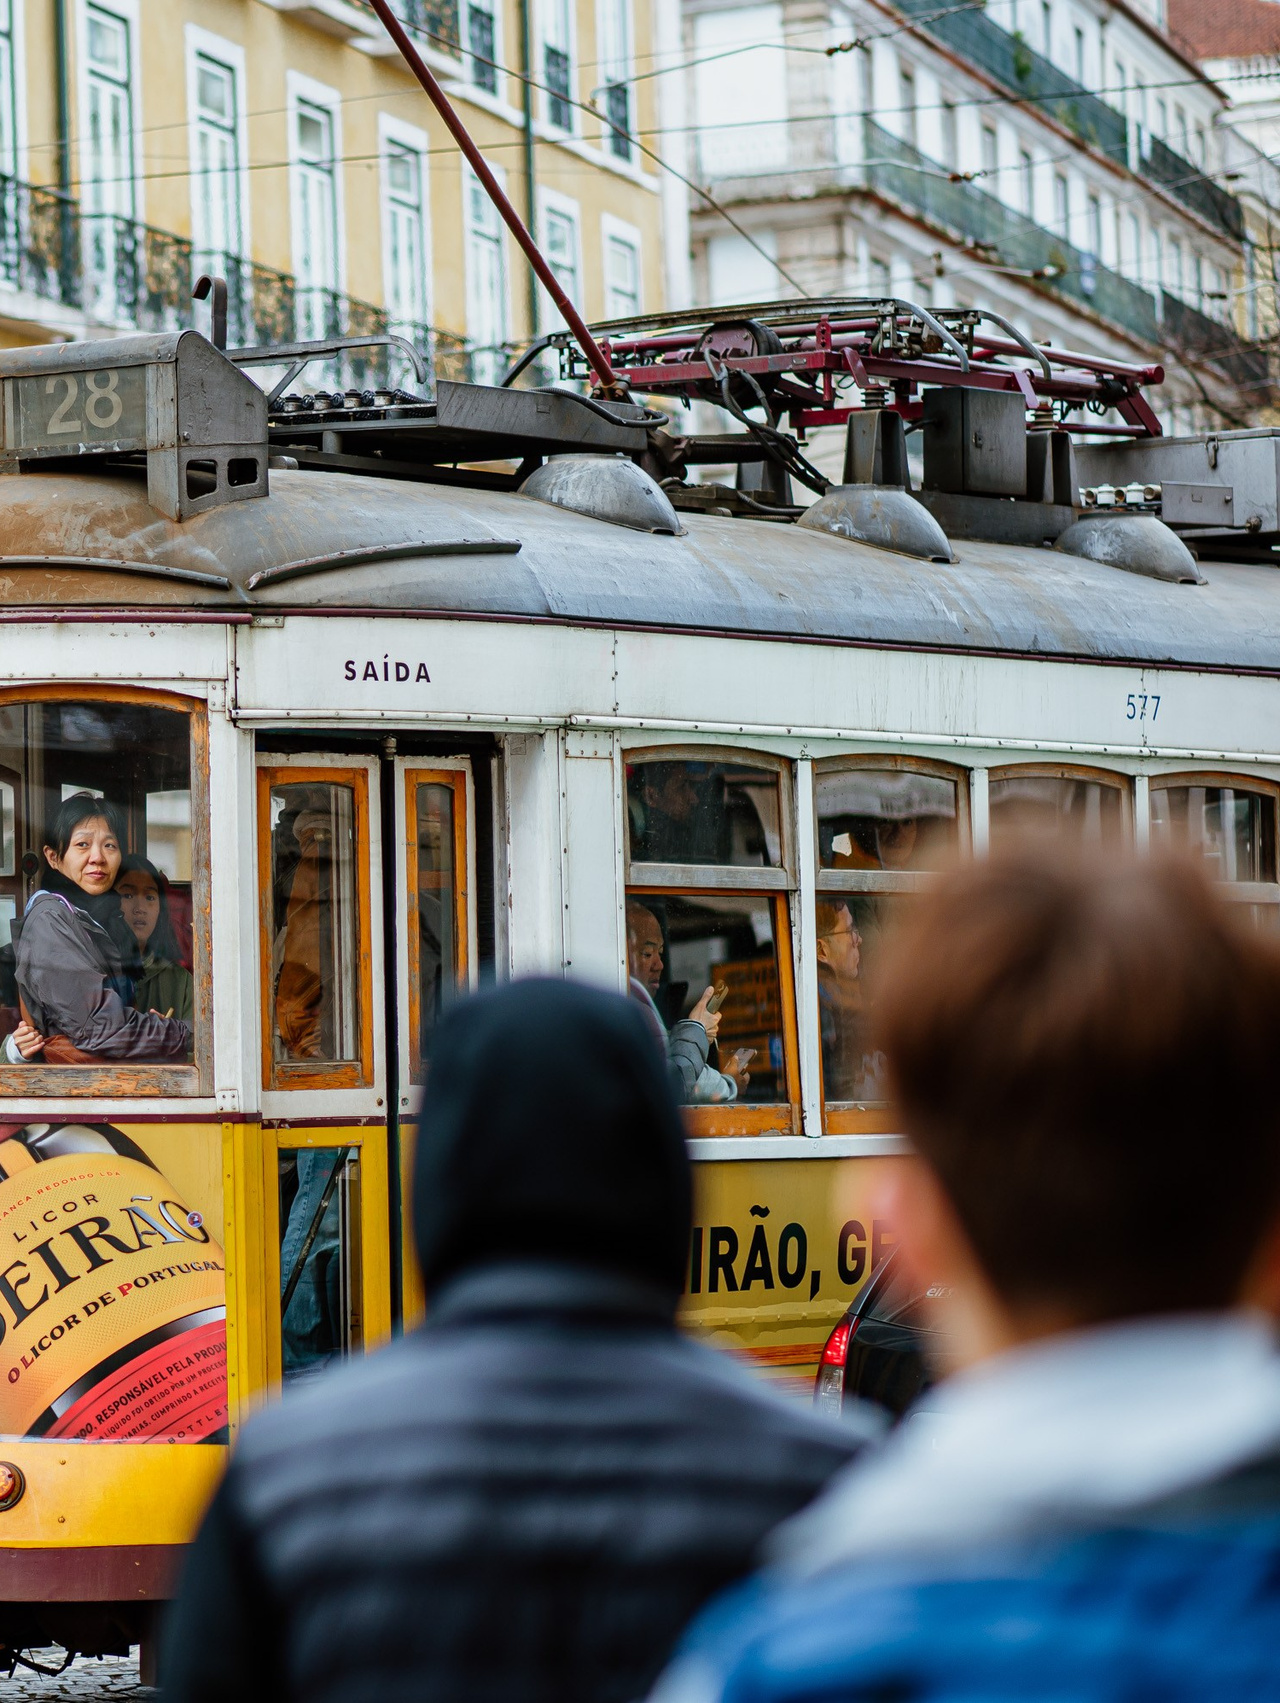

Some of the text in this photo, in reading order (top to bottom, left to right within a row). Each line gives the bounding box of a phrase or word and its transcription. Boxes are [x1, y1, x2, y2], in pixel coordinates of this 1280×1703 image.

[45, 368, 123, 435] 28
[344, 653, 431, 683] SAÍDA
[1126, 693, 1161, 721] 577
[36, 1172, 94, 1195] REDONDO
[12, 1193, 99, 1243] LICOR
[688, 1204, 821, 1302] IRÃO,
[7, 1260, 225, 1384] O LICOR DE PORTUGAL
[95, 1370, 168, 1425] RESPONSÁVEL
[166, 1356, 195, 1376] PELA
[131, 1405, 144, 1417] FOI
[144, 1388, 170, 1408] OBTIDO
[170, 1380, 186, 1392] POR
[185, 1373, 197, 1383] UM
[150, 1392, 192, 1421] CUMPRINDO
